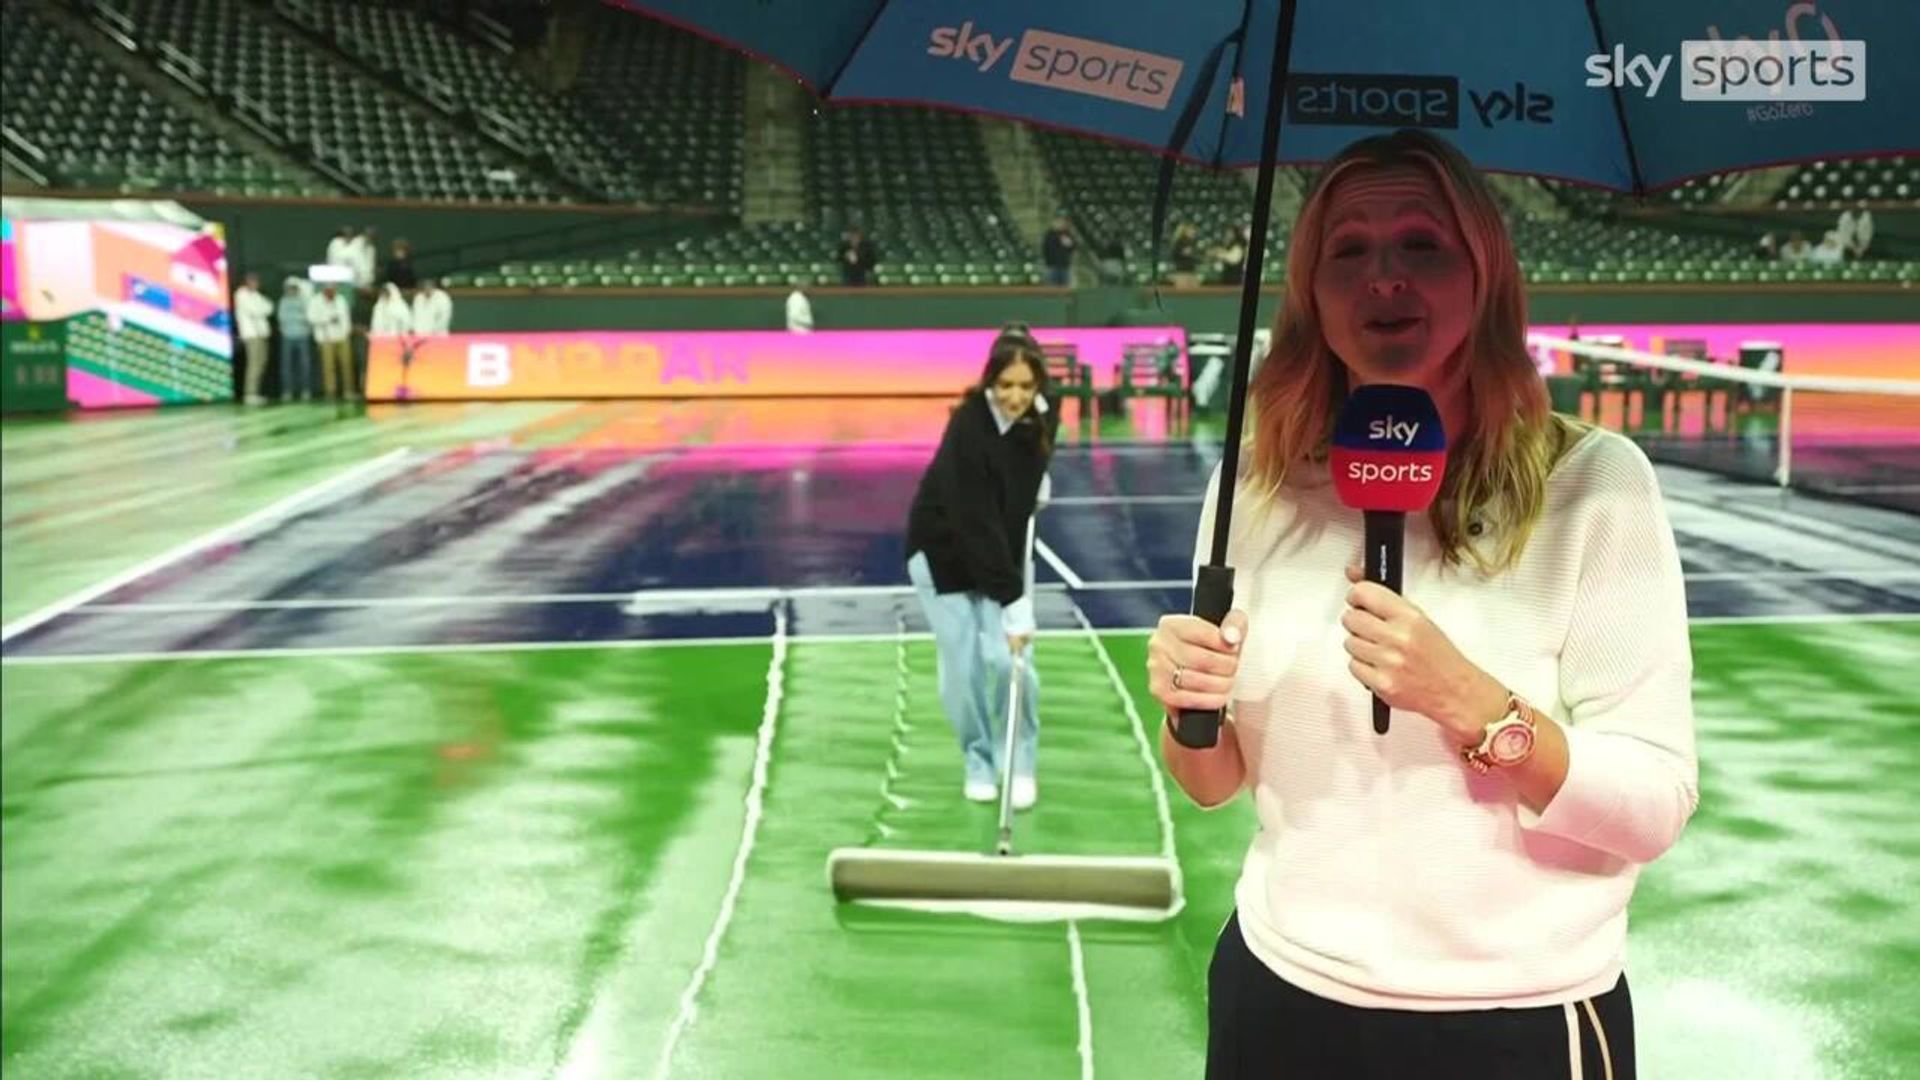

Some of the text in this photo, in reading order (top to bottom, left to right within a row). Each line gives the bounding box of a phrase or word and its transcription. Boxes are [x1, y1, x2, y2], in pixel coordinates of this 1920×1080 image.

[927, 21, 1168, 95] sky sports
[1369, 415, 1419, 446] sky
[1348, 461, 1433, 484] sports
